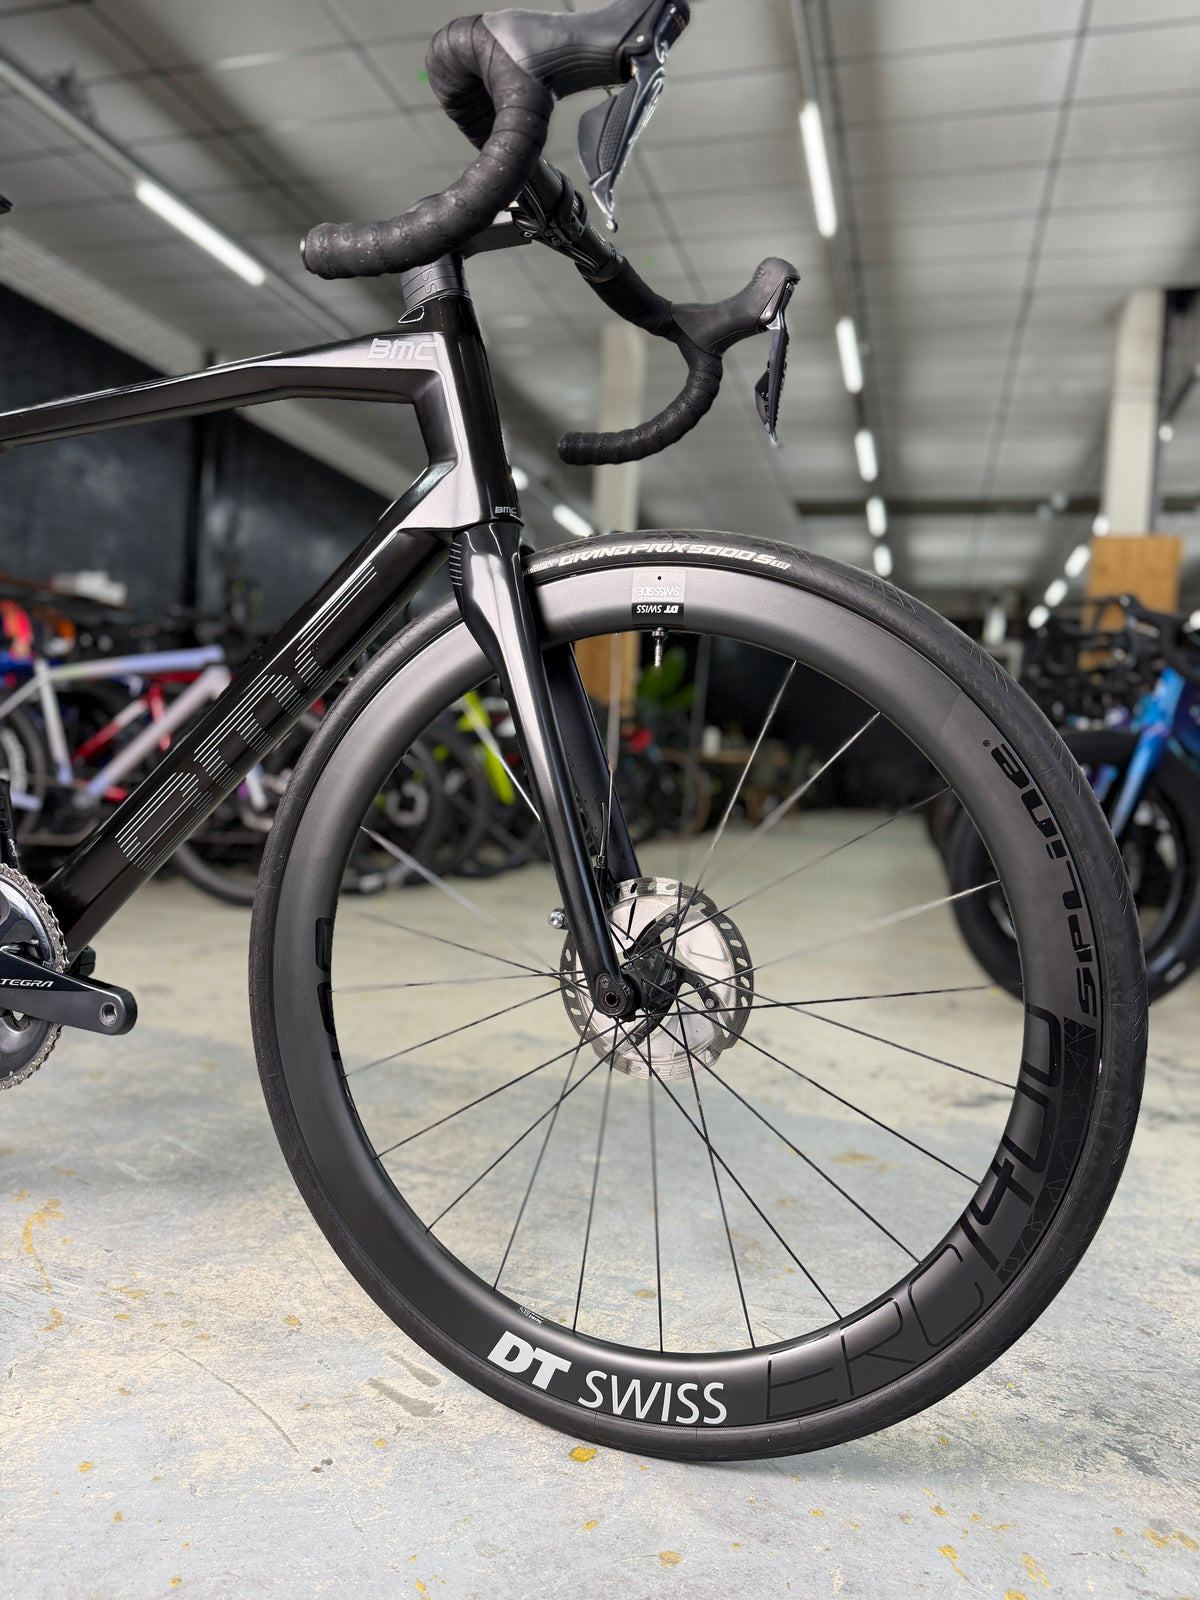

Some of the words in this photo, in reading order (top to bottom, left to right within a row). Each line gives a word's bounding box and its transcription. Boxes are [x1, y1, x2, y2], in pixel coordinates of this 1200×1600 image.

[367, 338, 439, 362] BMC
[494, 506, 518, 515] BMC
[636, 604, 662, 614] SWISS
[663, 605, 680, 614] DT
[0, 978, 54, 988] TEGRA
[487, 1330, 572, 1390] DT
[578, 1369, 728, 1425] SWISS
[766, 1243, 985, 1419] ERC
[958, 1002, 1063, 1273] 1400
